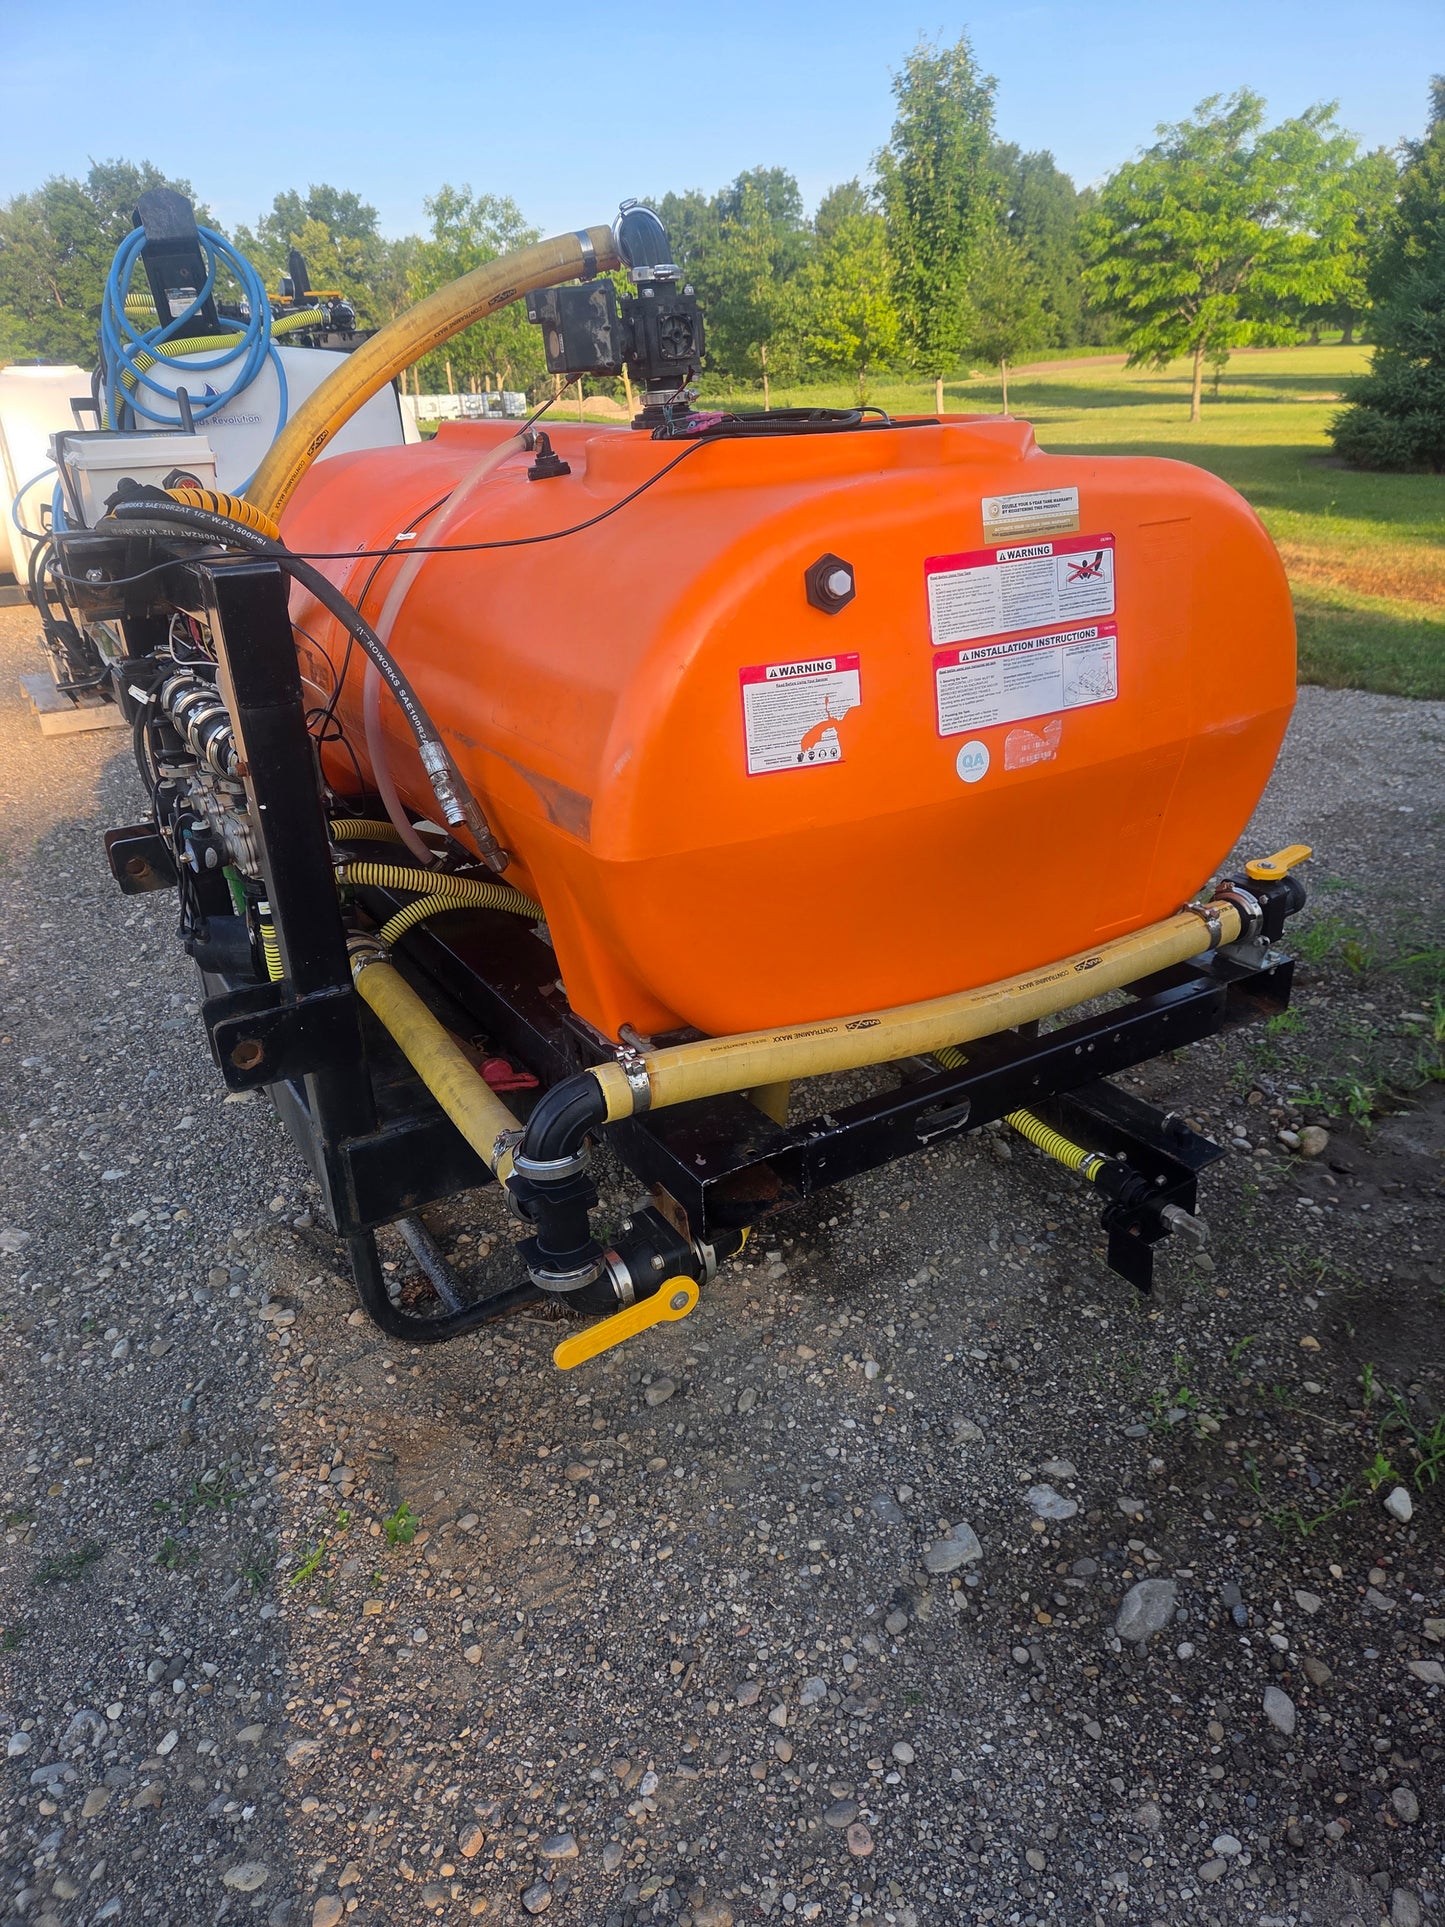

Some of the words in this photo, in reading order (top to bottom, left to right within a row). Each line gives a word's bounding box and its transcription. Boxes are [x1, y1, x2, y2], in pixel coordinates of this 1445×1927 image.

[212, 415, 260, 425] Revolution
[1053, 496, 1073, 504] WARRANTY
[145, 502, 191, 514] SAE100R2AT
[1007, 545, 1050, 560] WARNING
[970, 640, 1034, 660] INSTALLATION
[1036, 628, 1096, 648] INSTRUCTIONS
[354, 623, 400, 687] HROWORKS
[779, 661, 833, 676] WARNING
[962, 752, 984, 768] QA
[1035, 970, 1070, 986] CONTRAMINE
[1018, 982, 1035, 991] MAXX
[845, 1018, 881, 1031] MAXX
[773, 1034, 793, 1043] MAXX
[794, 1026, 839, 1040] CONTRAMINE
